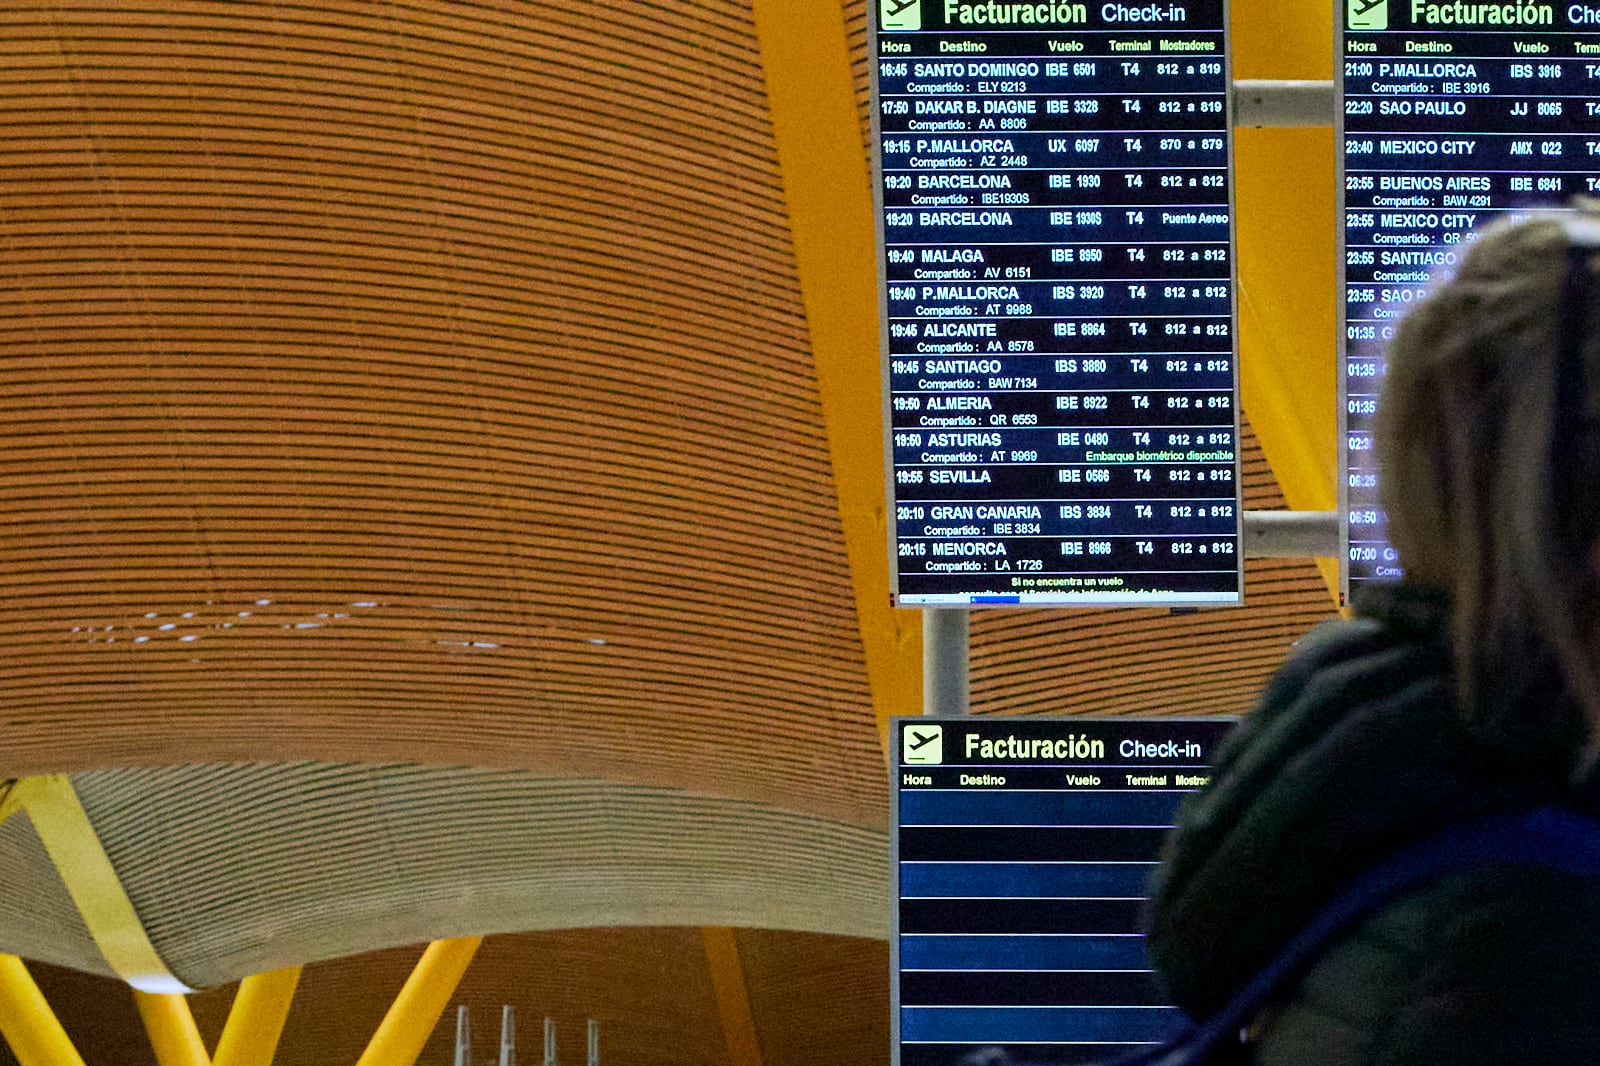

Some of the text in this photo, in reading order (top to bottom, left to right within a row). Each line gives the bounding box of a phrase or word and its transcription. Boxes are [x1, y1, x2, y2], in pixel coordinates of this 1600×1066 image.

[944, 0, 1186, 24] Facturación Check-in
[1411, 0, 1552, 25] Facturación
[914, 63, 1039, 77] SANTO DOMINGO
[1379, 64, 1476, 78] P.MALLORCA
[916, 100, 1036, 114] DAKAR B. DIAGNE
[1379, 102, 1466, 116] SAO PAULO
[917, 139, 1014, 153] P.MALLORCA
[1380, 141, 1476, 154] MEXICO CITY
[918, 175, 1011, 189] BARCELONA
[1380, 177, 1491, 191] BUENOS AIRES
[920, 212, 1012, 226] BARCELONA
[1381, 214, 1476, 228] MEXICO CITY
[922, 250, 984, 262] MALAGA
[1381, 252, 1456, 266] SANTIAGO
[922, 287, 1019, 301] P.MALLORCA
[924, 324, 997, 337] ALICANTE
[925, 360, 1001, 374] SANTIAGO
[927, 397, 992, 410] ALMERIA
[928, 433, 1001, 447] ASTURIAS
[930, 470, 991, 484] SEVILLA
[931, 506, 1042, 520] GRAN CANARIA
[932, 542, 1007, 556] MENORCA
[965, 734, 1201, 760] Facturación Check-in
[903, 774, 1101, 786] Hora Destino Vuelo
[1126, 775, 1166, 785] Terminal
